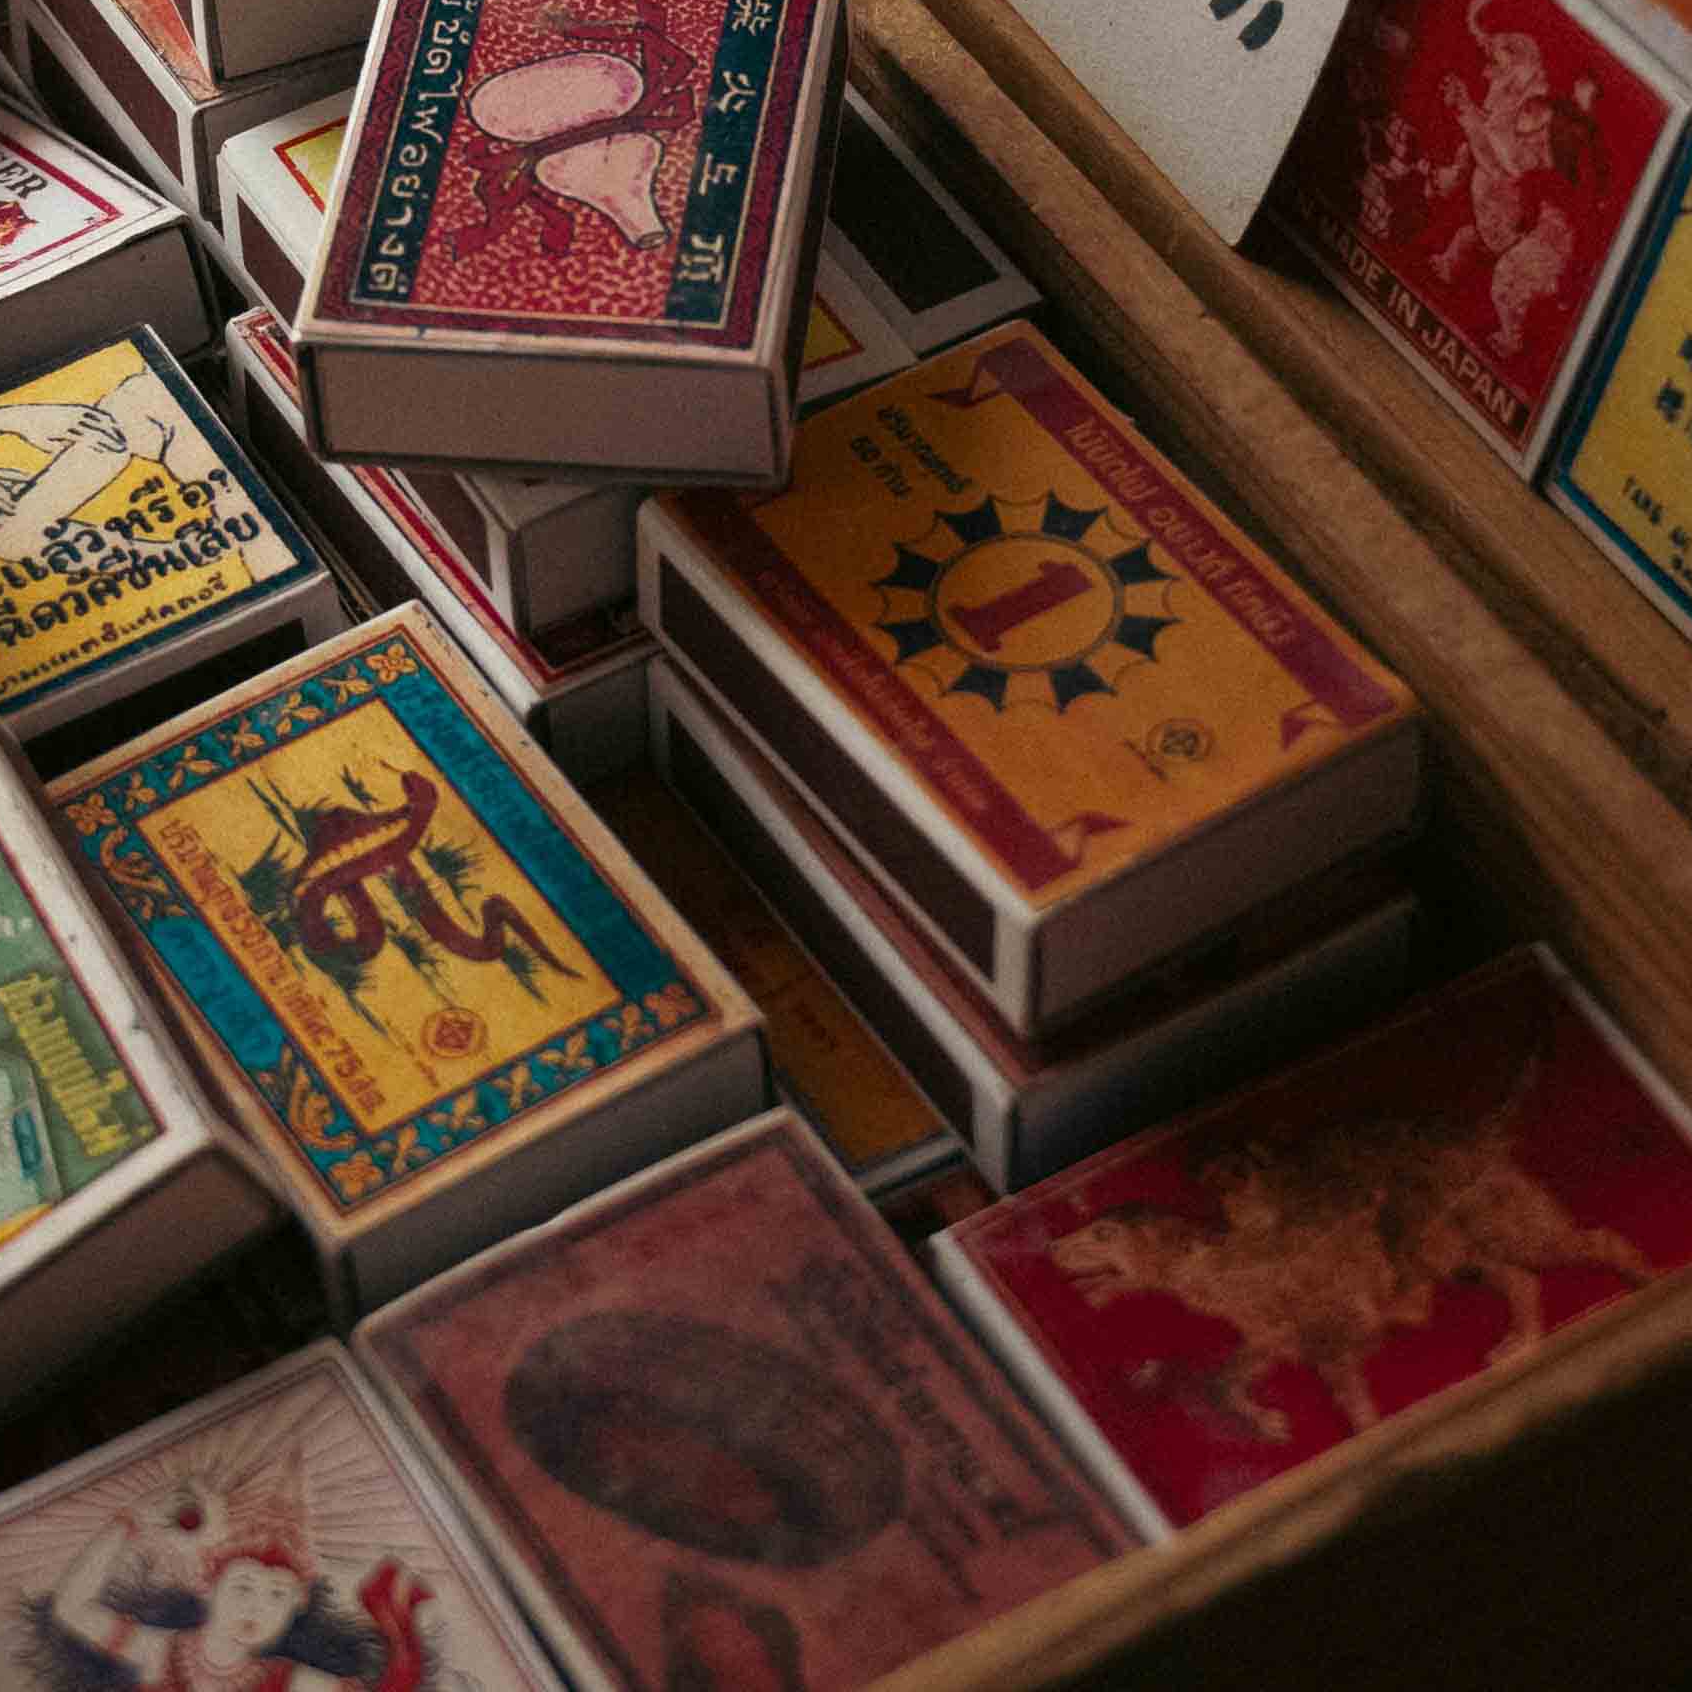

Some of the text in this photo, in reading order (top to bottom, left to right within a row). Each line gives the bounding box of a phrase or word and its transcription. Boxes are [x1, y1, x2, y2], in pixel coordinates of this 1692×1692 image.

[1379, 282, 1426, 328] IN
[1411, 318, 1527, 425] JAPAN
[947, 562, 1094, 652] 1
